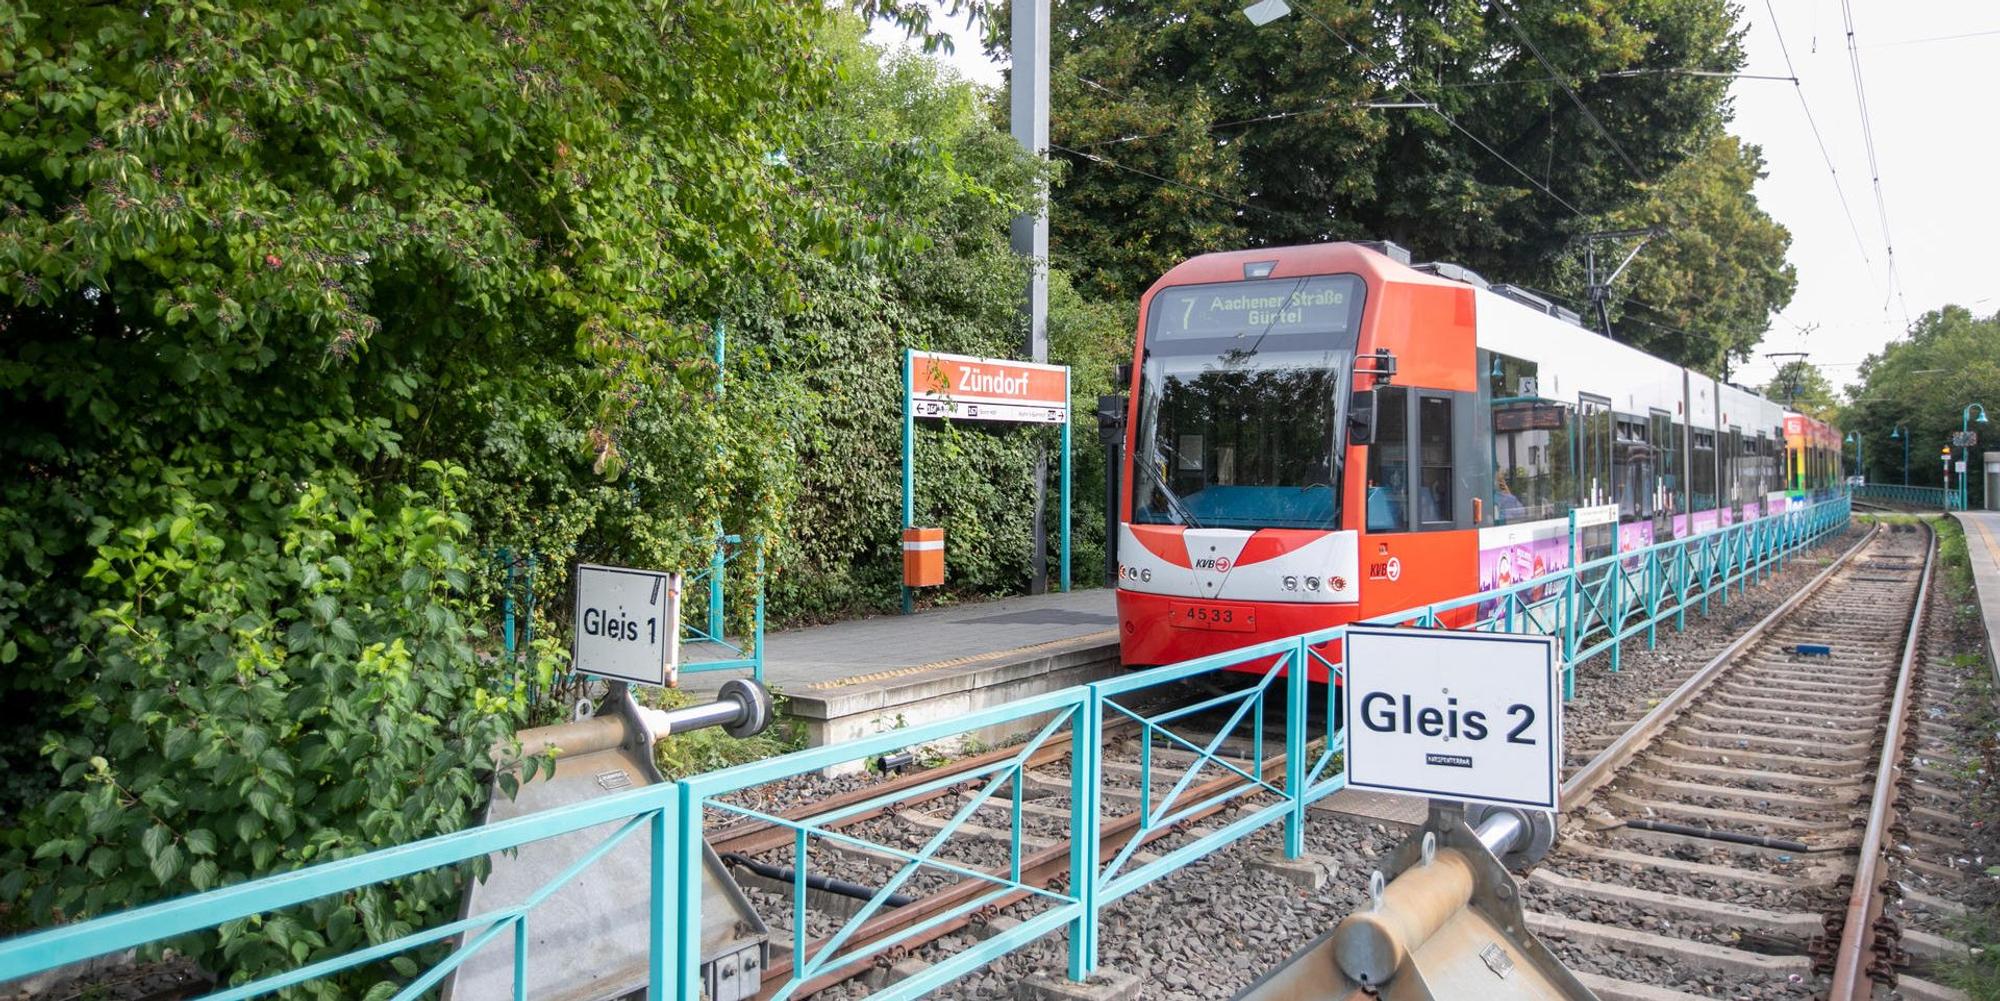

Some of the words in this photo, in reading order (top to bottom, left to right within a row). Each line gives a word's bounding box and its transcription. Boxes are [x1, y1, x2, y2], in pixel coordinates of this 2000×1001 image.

[1181, 298, 1195, 330] 7
[1210, 294, 1284, 312] Aachener
[1292, 288, 1343, 307] Straße
[1248, 307, 1302, 326] Gürtel
[959, 366, 1029, 396] Zündorf
[1196, 558, 1216, 570] KVB
[1370, 563, 1388, 577] KVB
[583, 607, 638, 642] Gleis
[647, 617, 656, 644] 1
[1186, 609, 1233, 624] 4533
[1360, 691, 1489, 741] Gleis
[1506, 703, 1536, 746] 2
